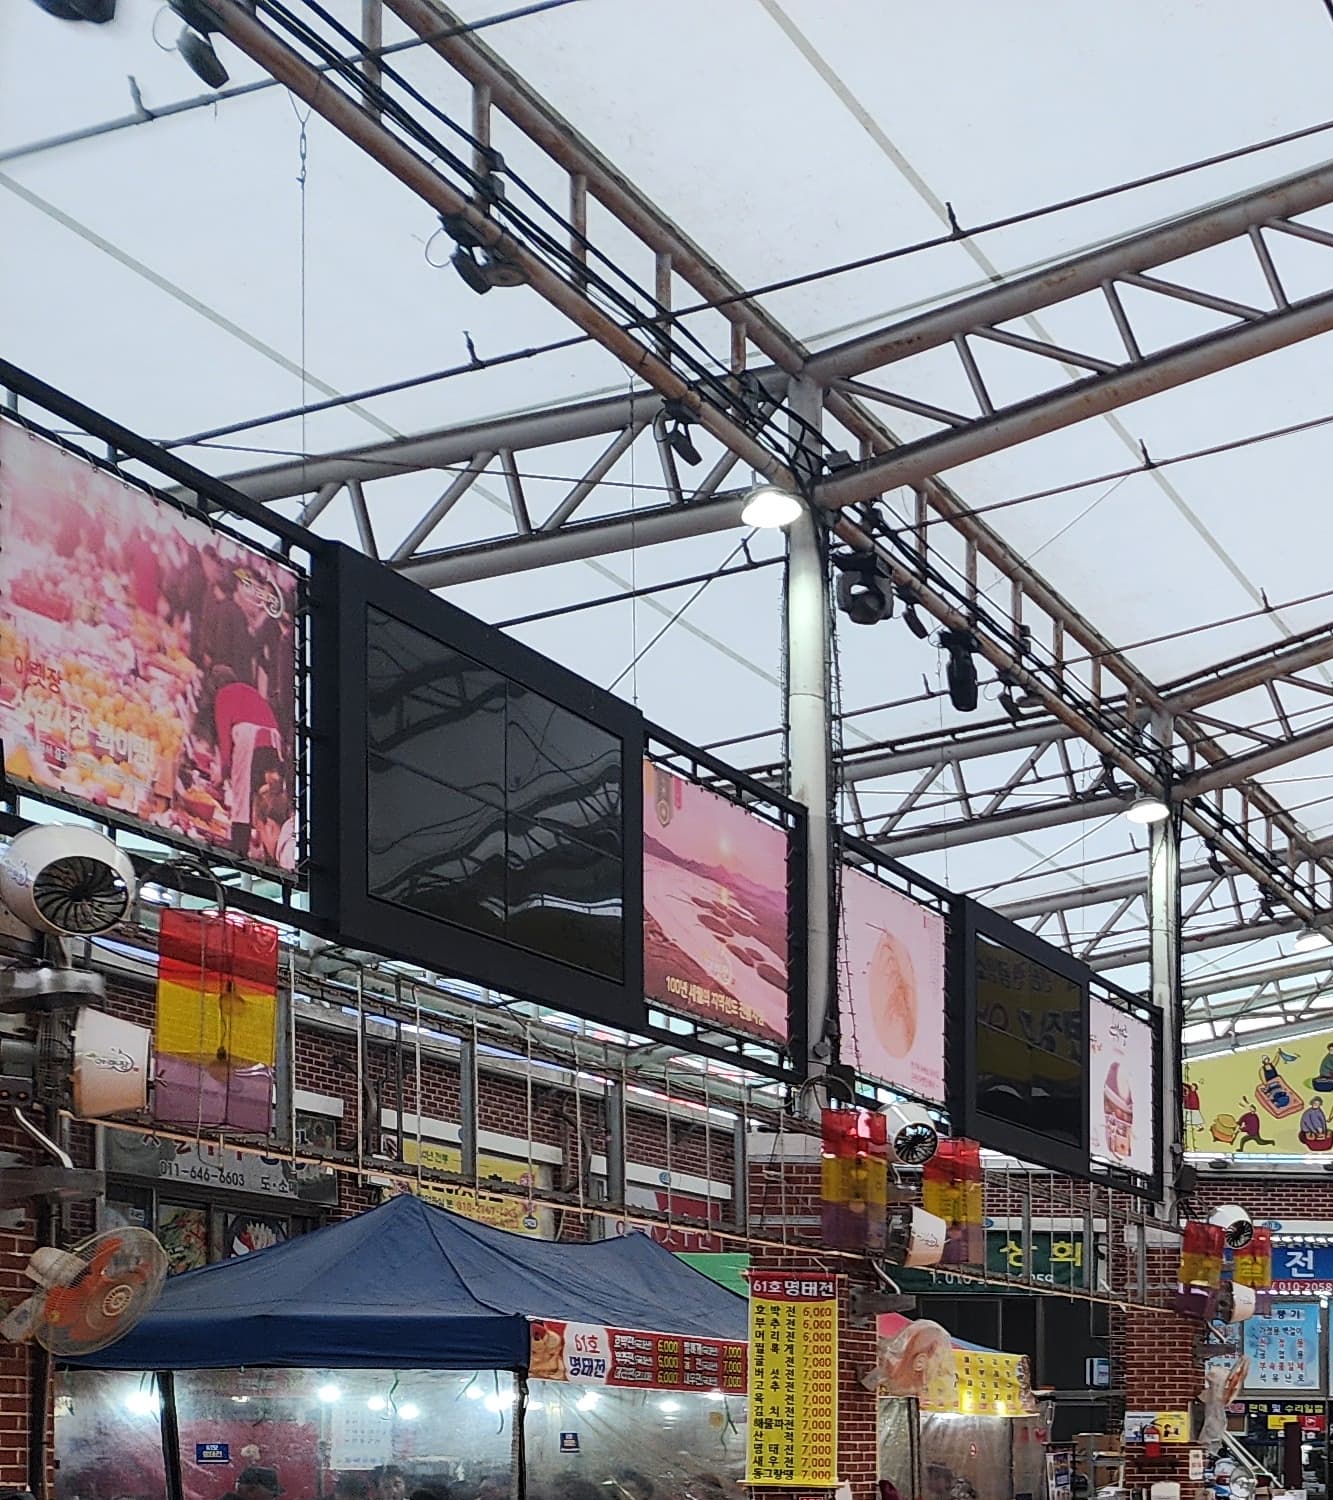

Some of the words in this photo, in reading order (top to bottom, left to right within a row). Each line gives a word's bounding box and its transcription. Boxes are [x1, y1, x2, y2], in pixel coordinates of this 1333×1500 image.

[159, 1159, 246, 1187] 011-646-6603
[753, 1280, 782, 1293] 61호
[784, 1280, 835, 1297] 명태전
[568, 1355, 607, 1379] 명태전
